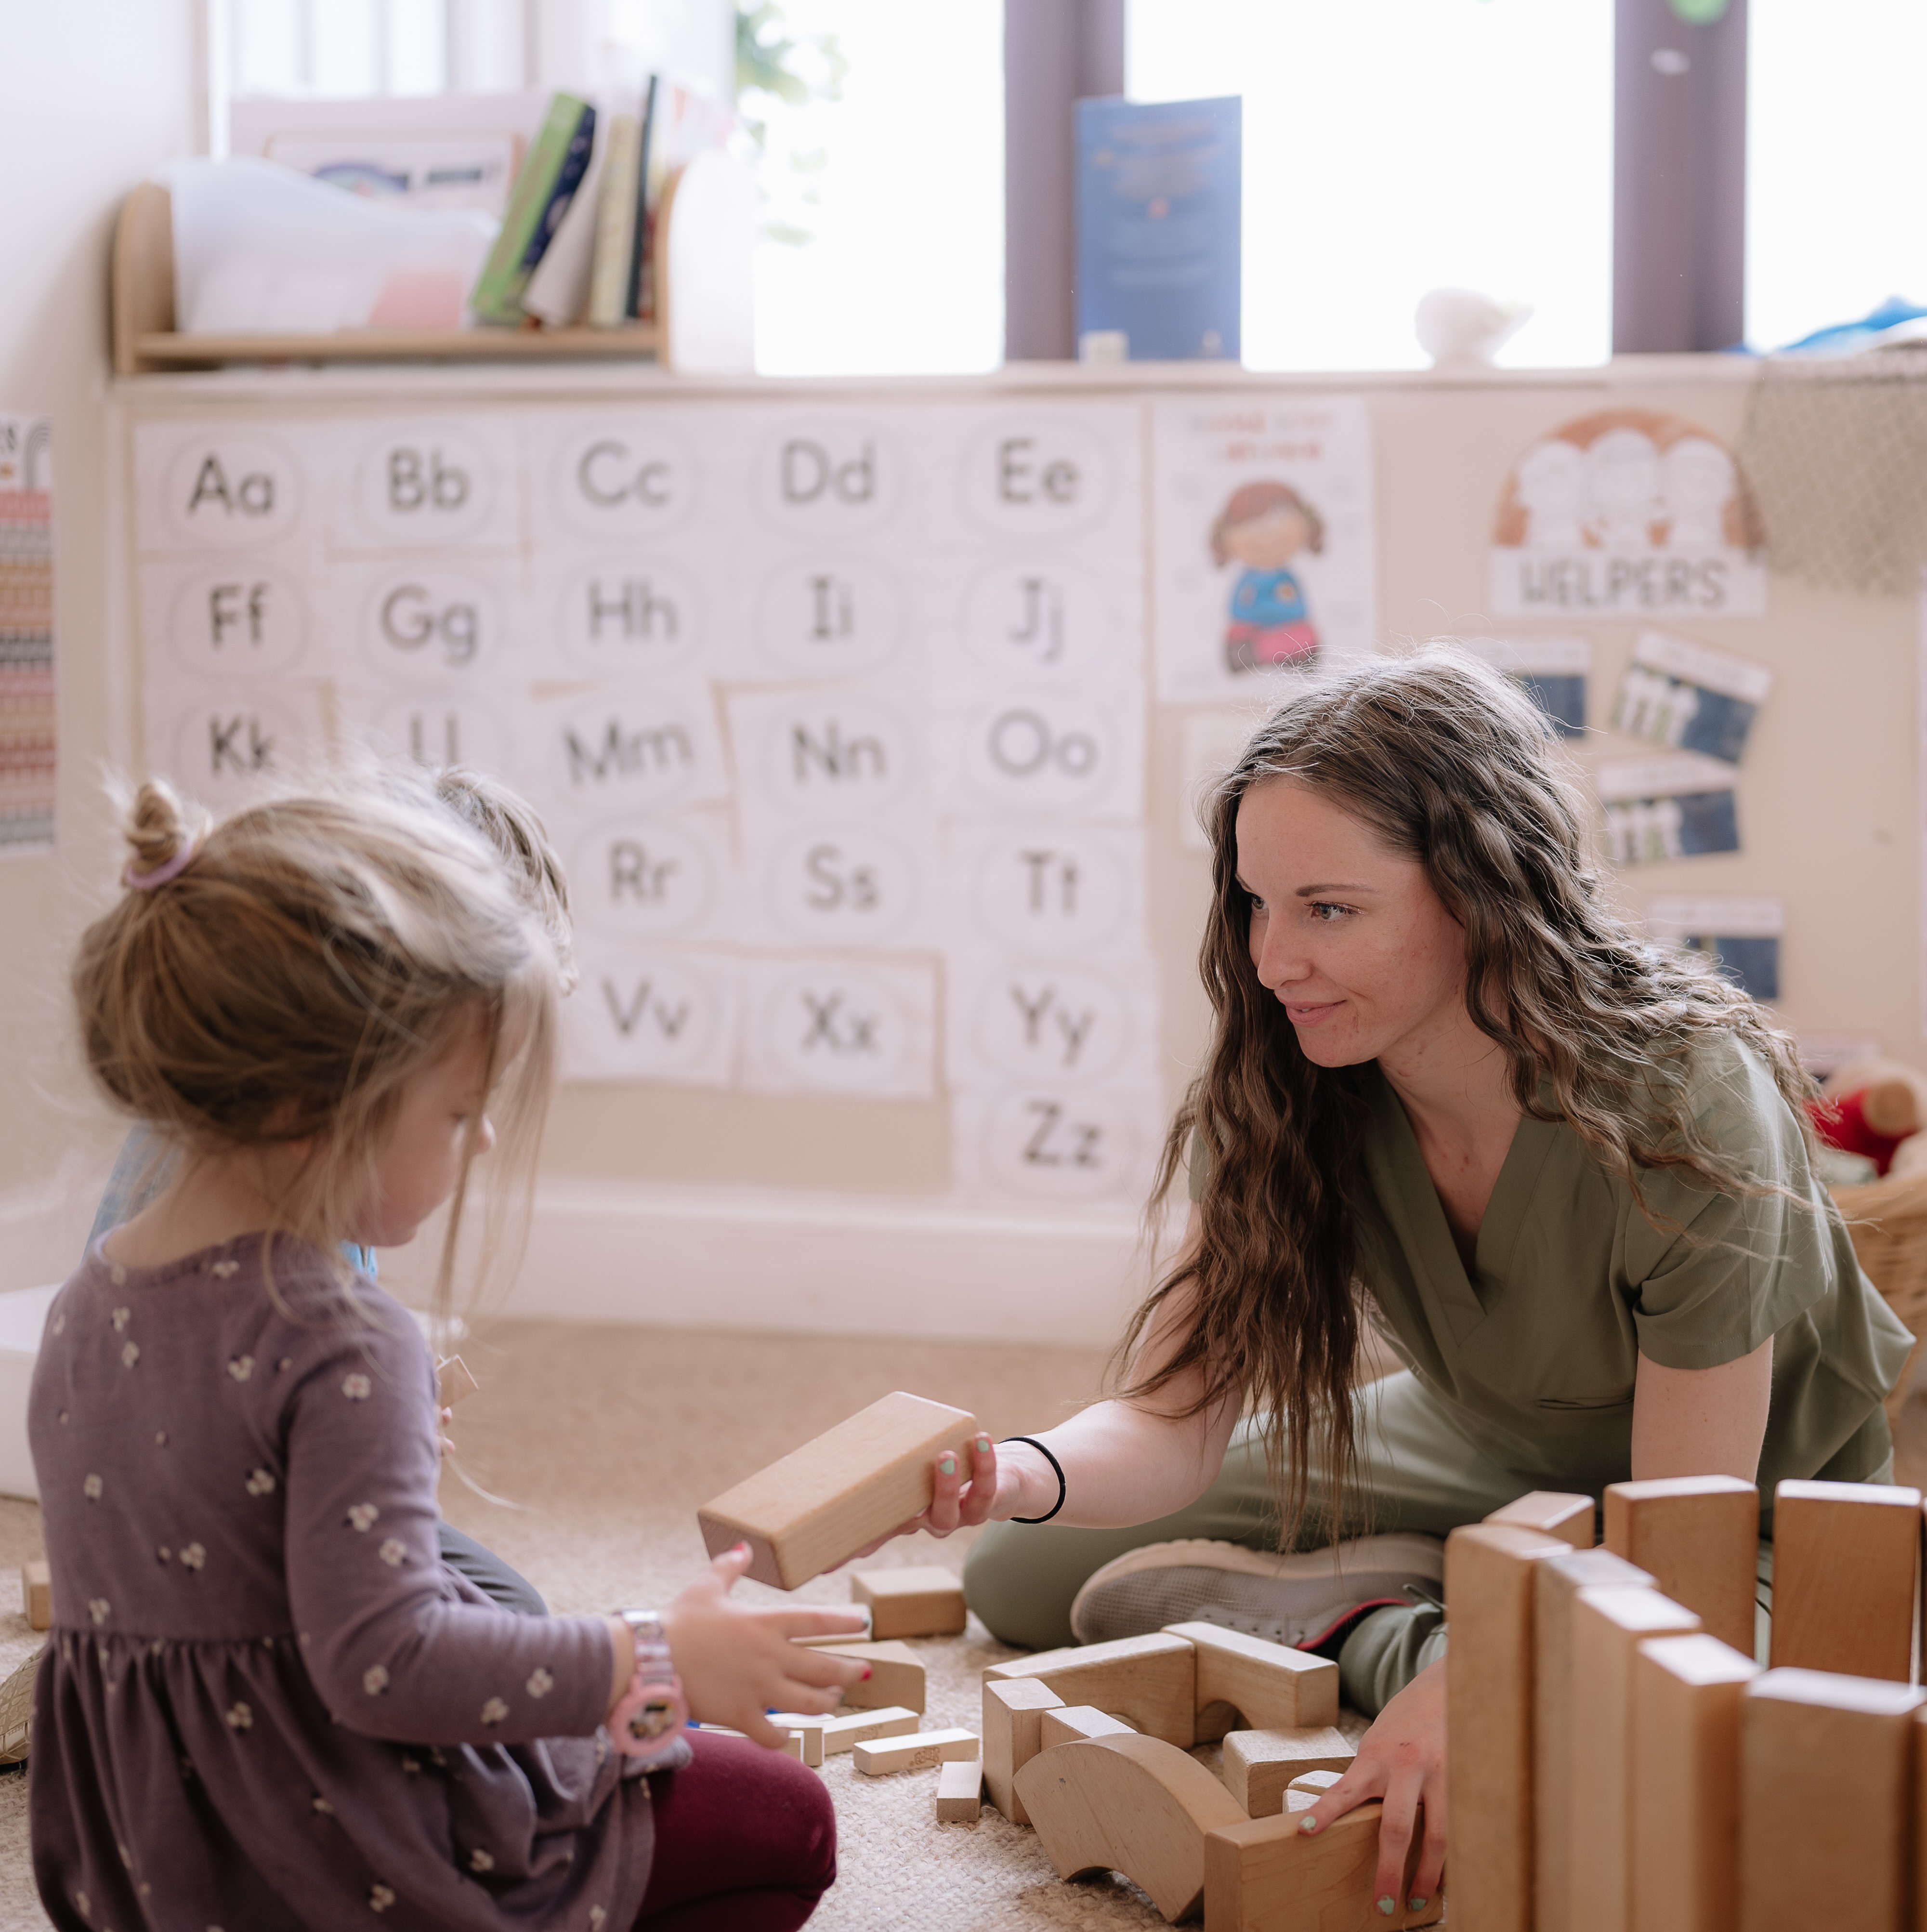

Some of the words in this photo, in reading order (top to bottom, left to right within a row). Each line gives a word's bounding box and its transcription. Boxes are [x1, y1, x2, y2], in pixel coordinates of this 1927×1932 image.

[187, 453, 275, 517] Aa
[387, 447, 470, 513] Bb
[576, 440, 669, 509] Cc
[781, 439, 876, 506] Dd
[998, 437, 1079, 505] Ee
[208, 582, 270, 648] Ff
[588, 579, 679, 642] Hh
[810, 575, 852, 642] Ii
[1520, 556, 1727, 609] HELPERS
[380, 584, 479, 667] Gg
[1009, 576, 1063, 664] Jj
[209, 717, 273, 774] Kk
[563, 718, 694, 787] Mm
[791, 722, 887, 782] Nn
[987, 708, 1098, 779] Oo
[609, 840, 675, 904] Rr
[805, 844, 880, 912] Ss
[1020, 848, 1080, 915] Tt
[601, 977, 689, 1040] Vv
[801, 990, 878, 1053] Xx
[1010, 986, 1093, 1066] Yy
[1022, 1100, 1103, 1170] Zz
